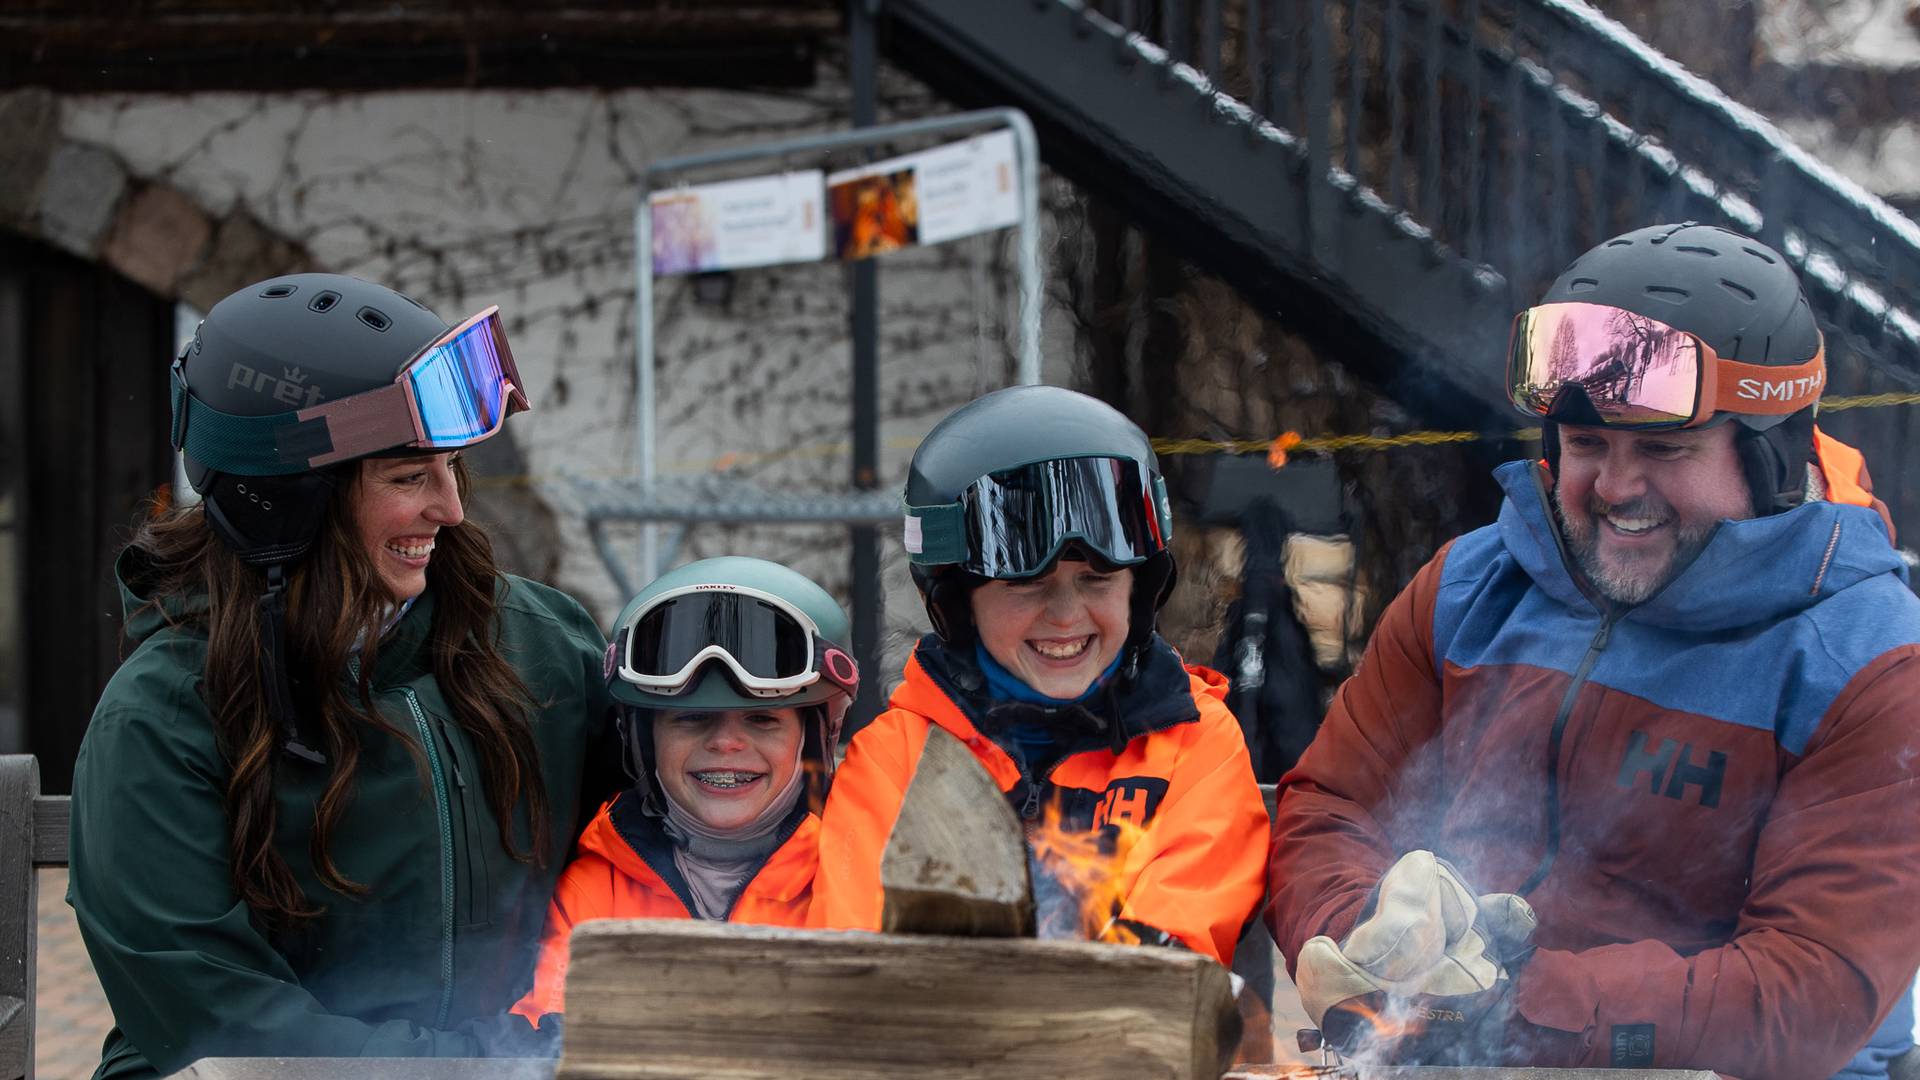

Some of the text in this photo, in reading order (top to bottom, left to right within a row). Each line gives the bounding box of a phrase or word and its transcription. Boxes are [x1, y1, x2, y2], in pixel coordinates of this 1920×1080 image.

[1737, 369, 1822, 401] SMITH
[1616, 730, 1727, 809] HH
[1410, 1006, 1465, 1022] ESTRA
